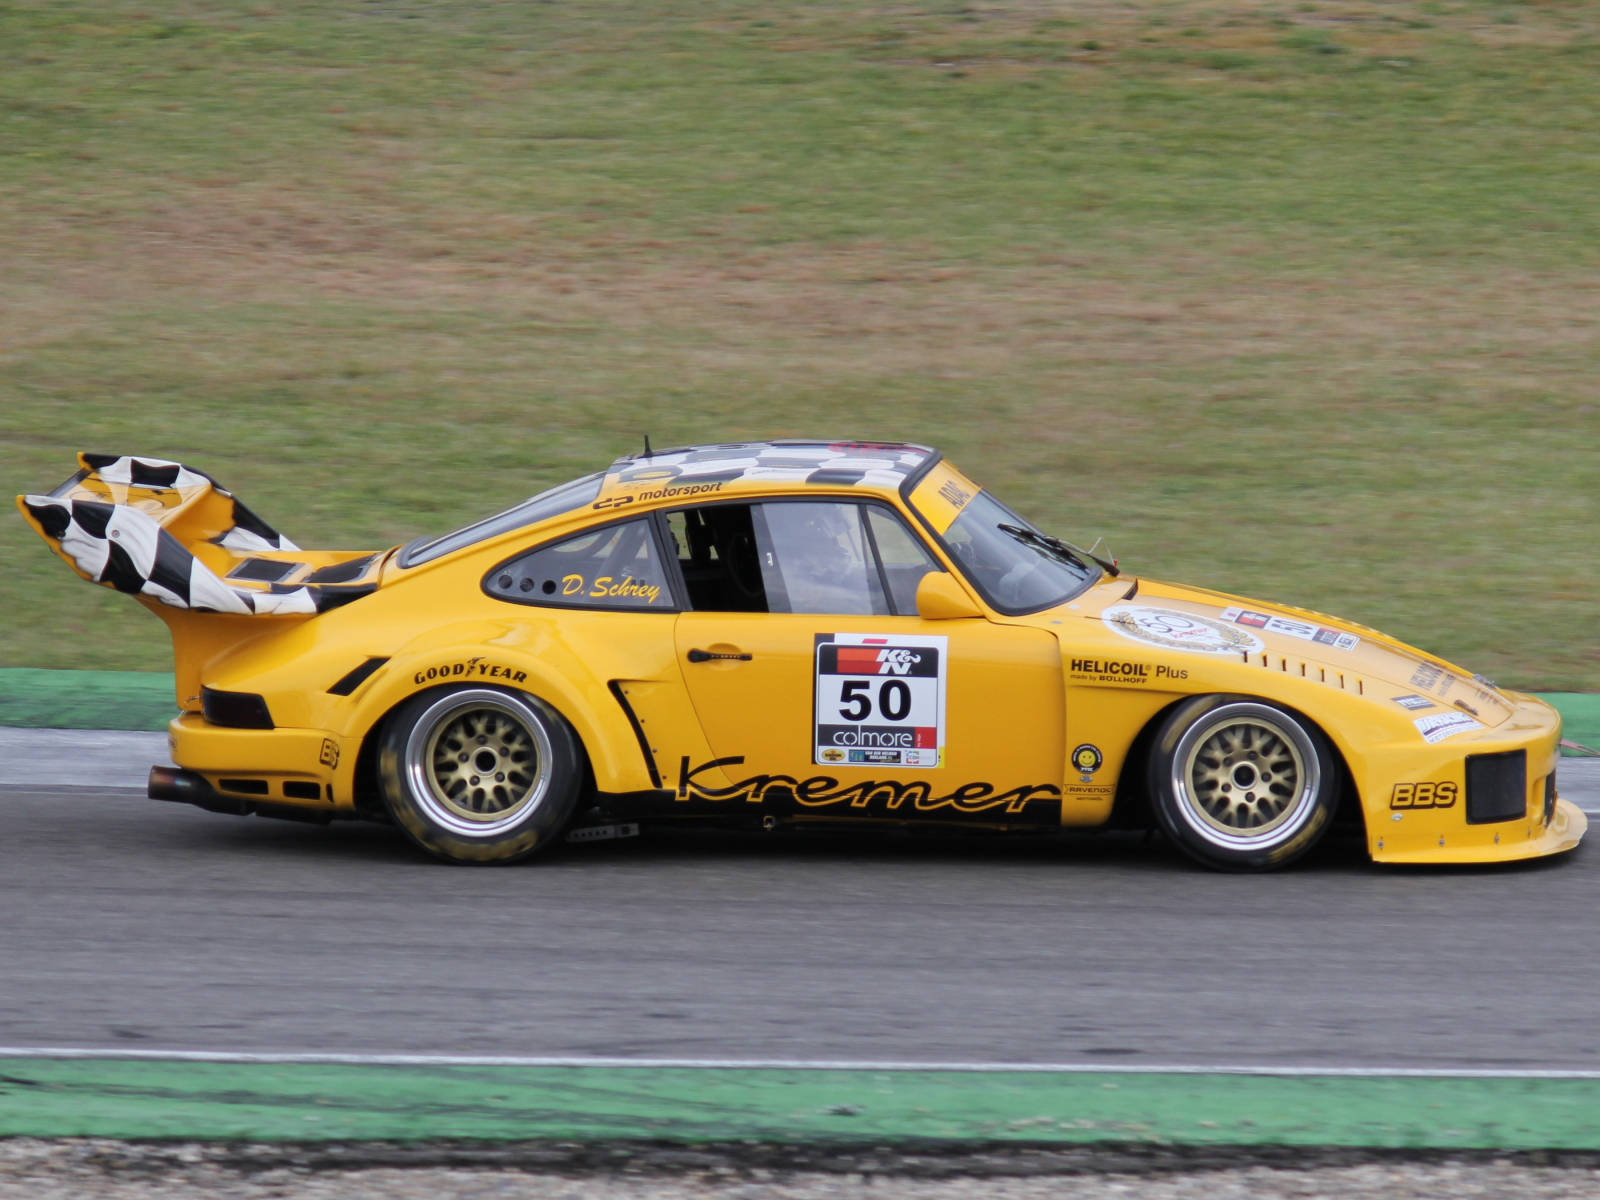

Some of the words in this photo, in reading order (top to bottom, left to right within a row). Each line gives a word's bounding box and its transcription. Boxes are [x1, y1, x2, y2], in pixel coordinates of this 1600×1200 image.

[639, 482, 723, 501] motorsport
[938, 480, 971, 510] ADAC
[561, 574, 585, 596] D.
[589, 576, 661, 604] Schrey
[1156, 665, 1189, 680] Plus
[839, 679, 912, 721] 50
[833, 724, 913, 747] colmore
[675, 755, 1062, 813] Kremer
[1390, 781, 1458, 810] BBS
